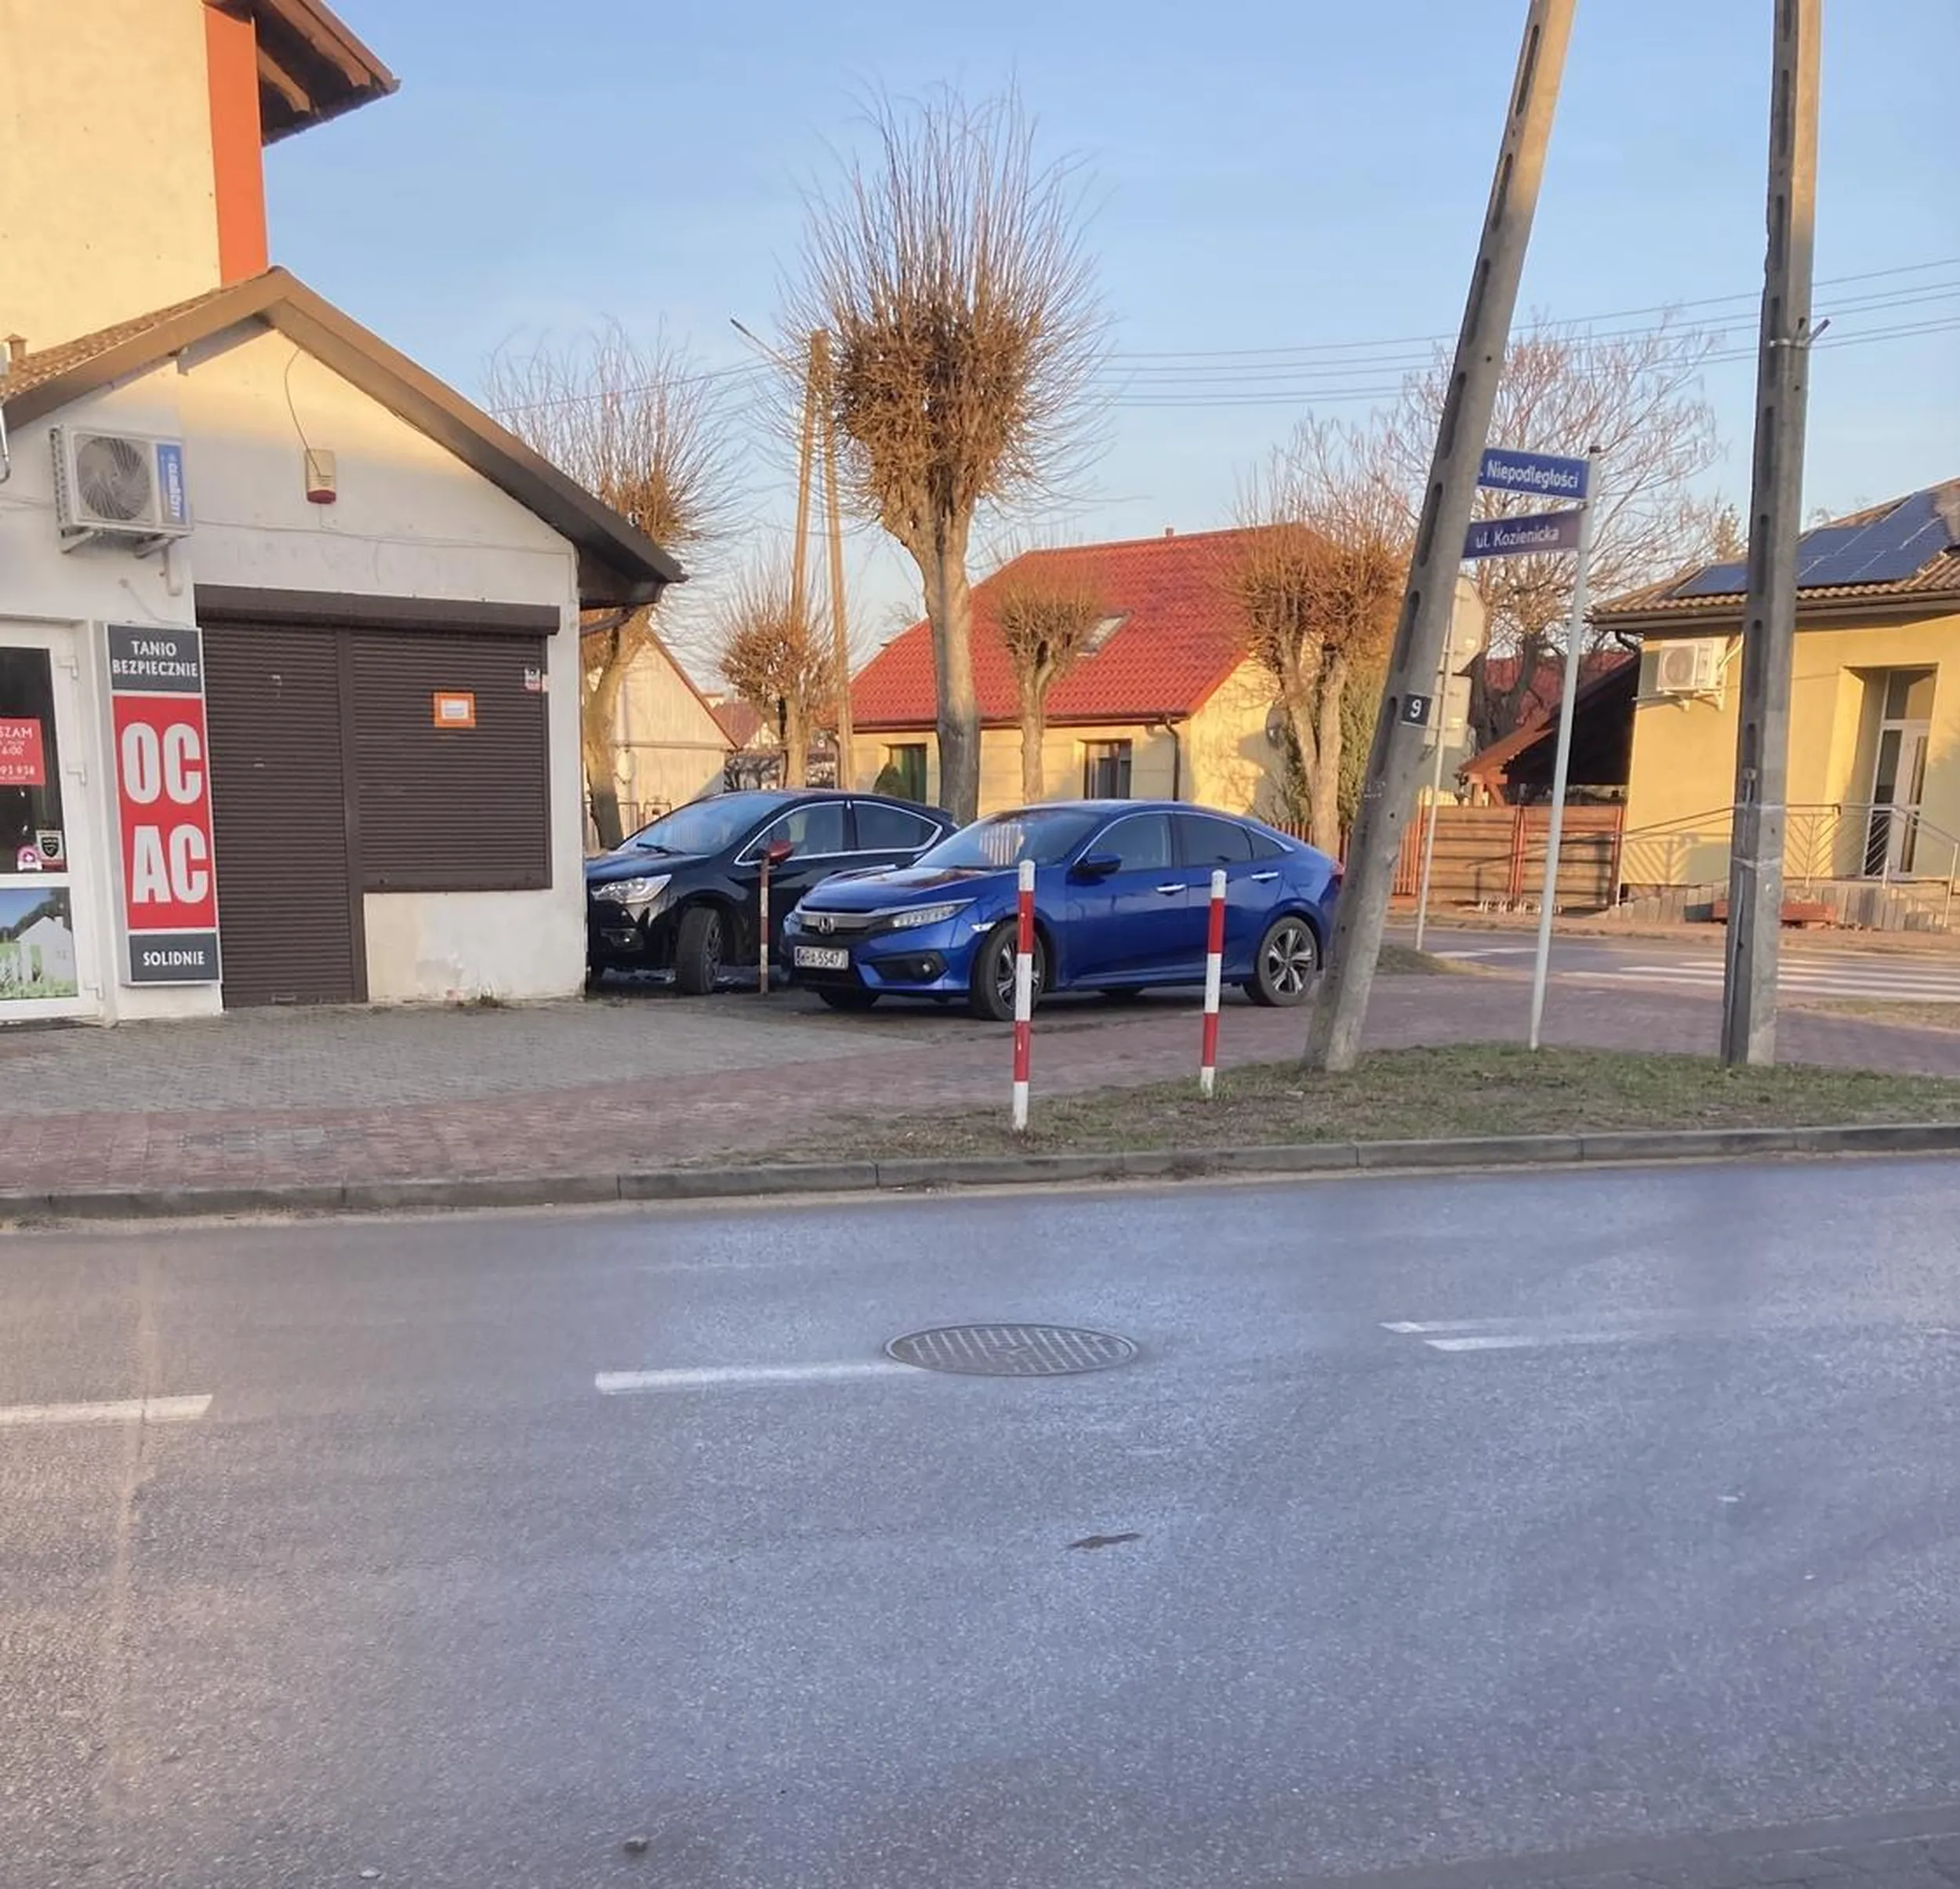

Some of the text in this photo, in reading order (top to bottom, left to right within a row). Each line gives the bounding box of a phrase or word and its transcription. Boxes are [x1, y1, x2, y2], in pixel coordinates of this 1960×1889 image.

[1486, 460, 1578, 489] Niepodległości
[1494, 524, 1559, 547] Kozienicka
[131, 641, 176, 656] TANIO
[111, 659, 198, 677] BEZPIECZNIE
[1410, 699, 1422, 717] 9
[122, 722, 202, 805] OC
[132, 823, 209, 904] AC
[143, 950, 205, 967] SOLIDNIE
